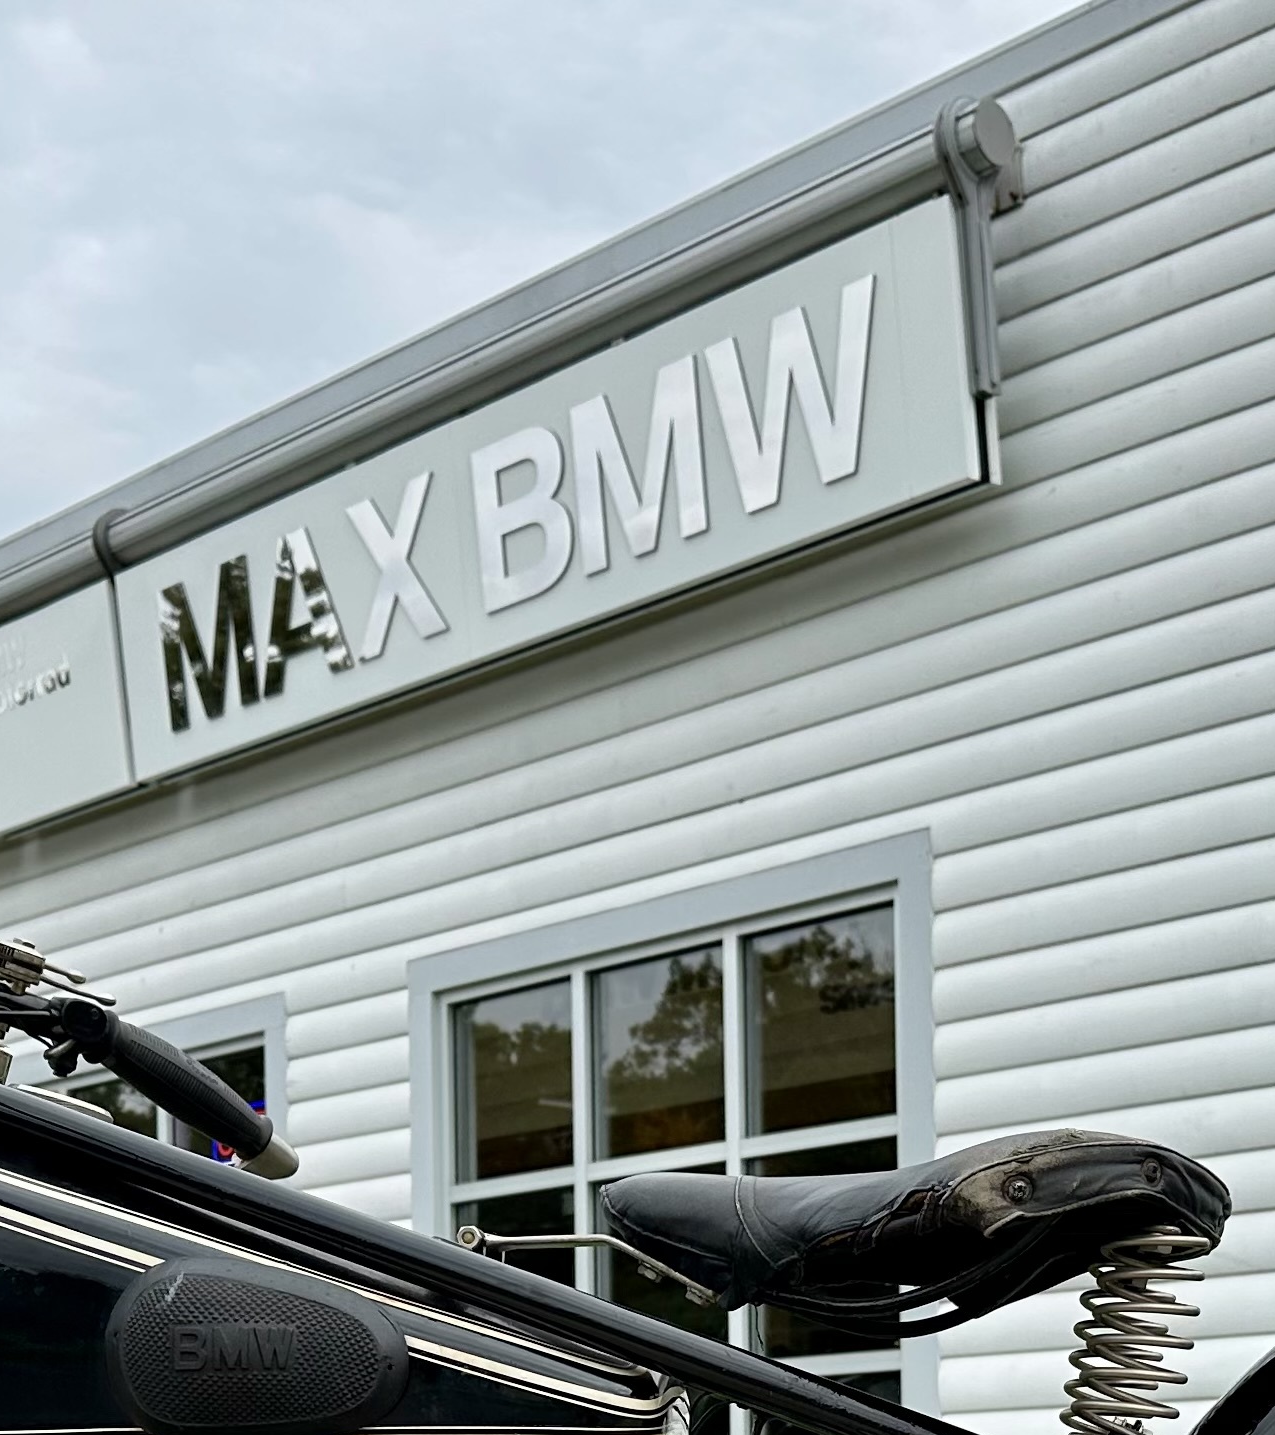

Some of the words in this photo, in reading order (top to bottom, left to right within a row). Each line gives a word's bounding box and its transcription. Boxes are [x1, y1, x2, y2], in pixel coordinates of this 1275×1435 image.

[158, 471, 451, 733] MAX
[470, 273, 877, 614] BMW
[171, 1325, 295, 1372] BMW
